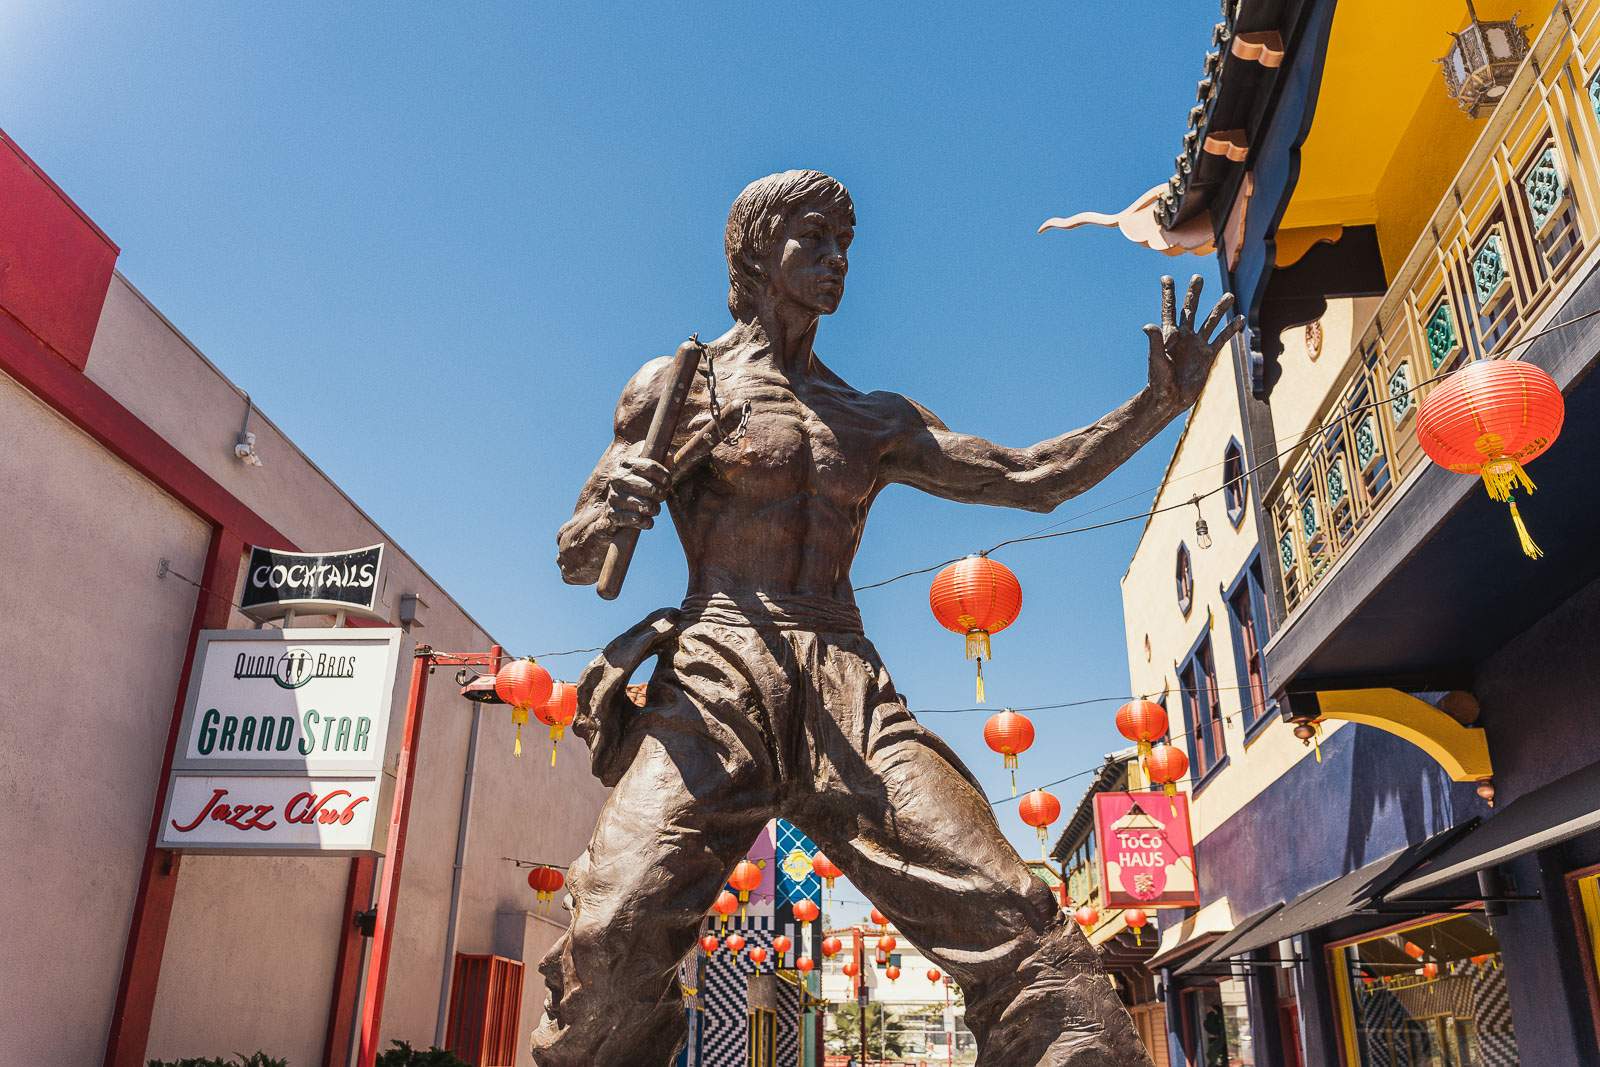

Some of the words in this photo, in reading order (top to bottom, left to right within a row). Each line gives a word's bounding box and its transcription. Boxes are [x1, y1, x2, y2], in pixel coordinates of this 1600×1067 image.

[252, 564, 374, 589] COCKTAILS
[198, 708, 295, 755] GRAND
[298, 709, 371, 755] STAR
[171, 789, 277, 832] Jazz
[284, 789, 370, 825] Club
[1119, 852, 1165, 868] HAUS
